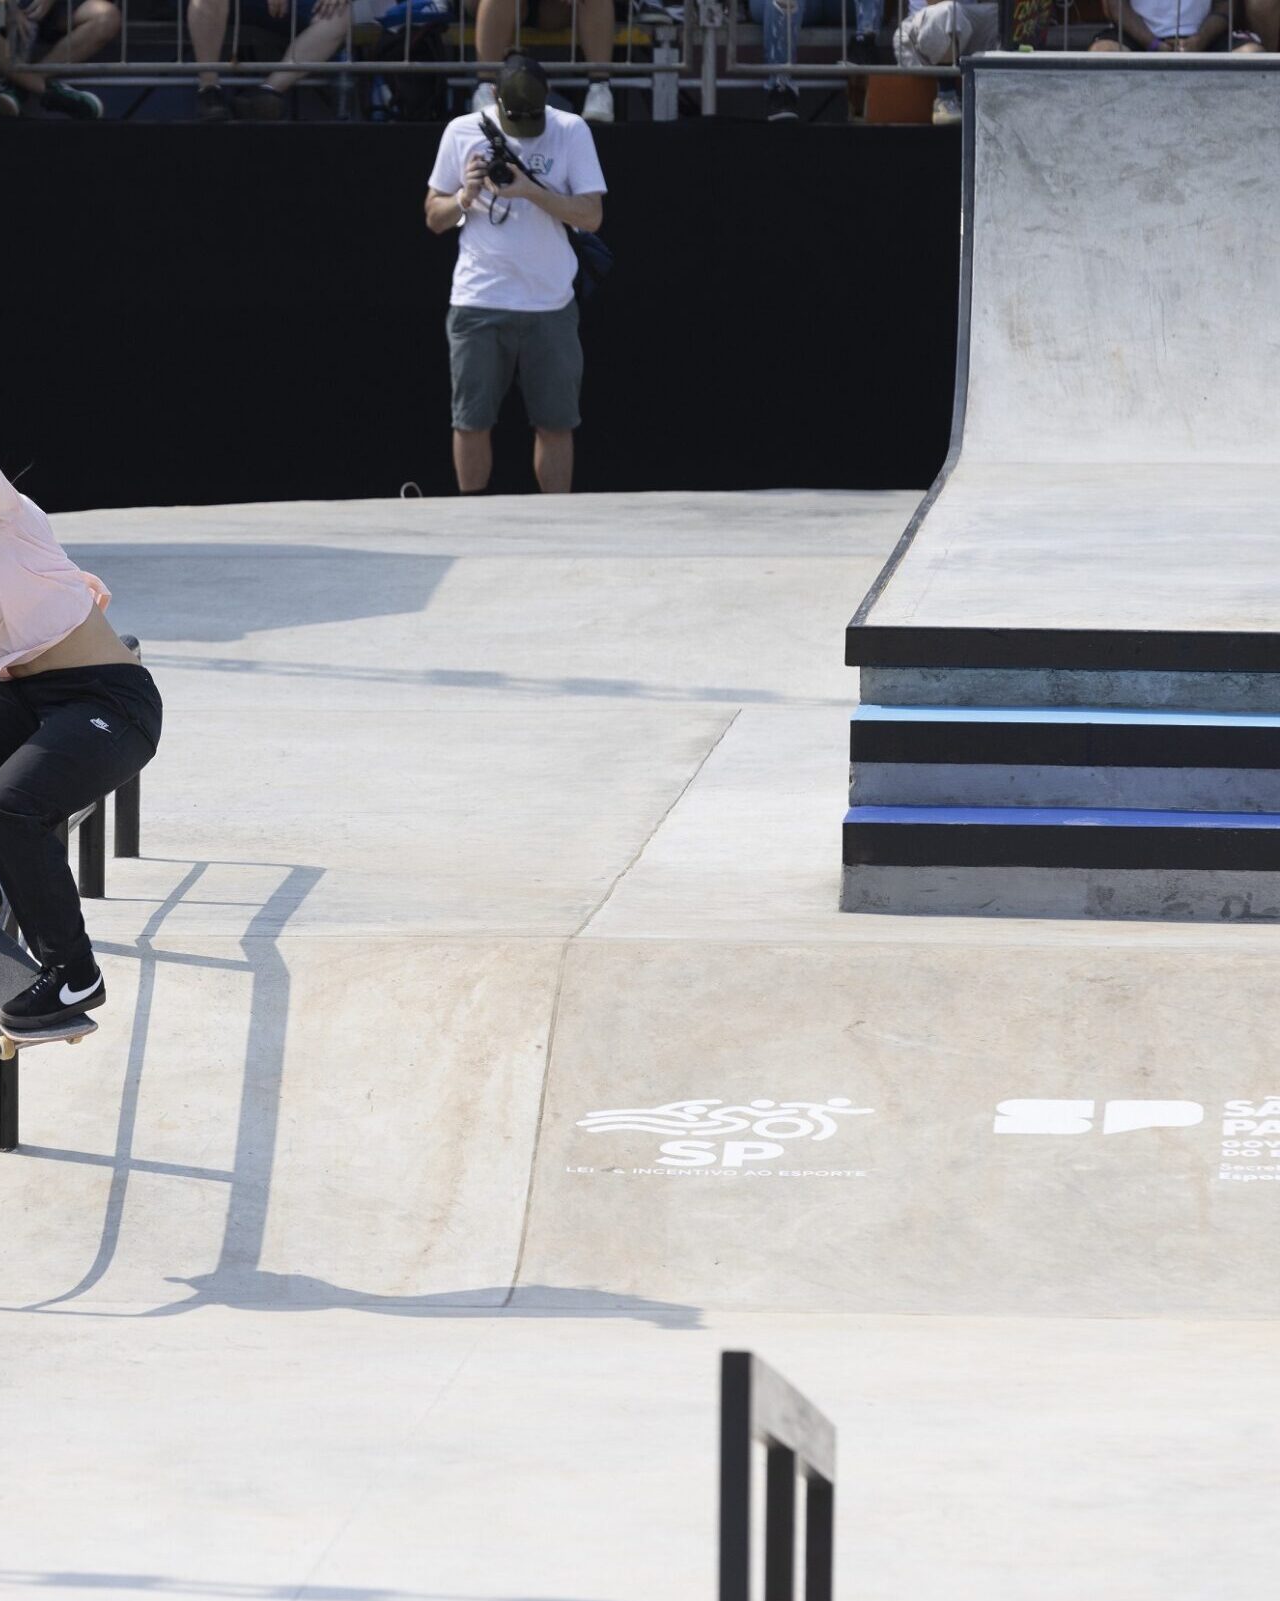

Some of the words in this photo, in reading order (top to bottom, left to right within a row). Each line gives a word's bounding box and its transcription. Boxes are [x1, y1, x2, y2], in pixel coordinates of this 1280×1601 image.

[993, 1098, 1204, 1135] SP
[655, 1139, 785, 1168] SP
[566, 1166, 594, 1174] LEI
[633, 1168, 737, 1176] INCENTIVO
[744, 1169, 772, 1177] AO
[779, 1170, 867, 1178] ESPORTE
